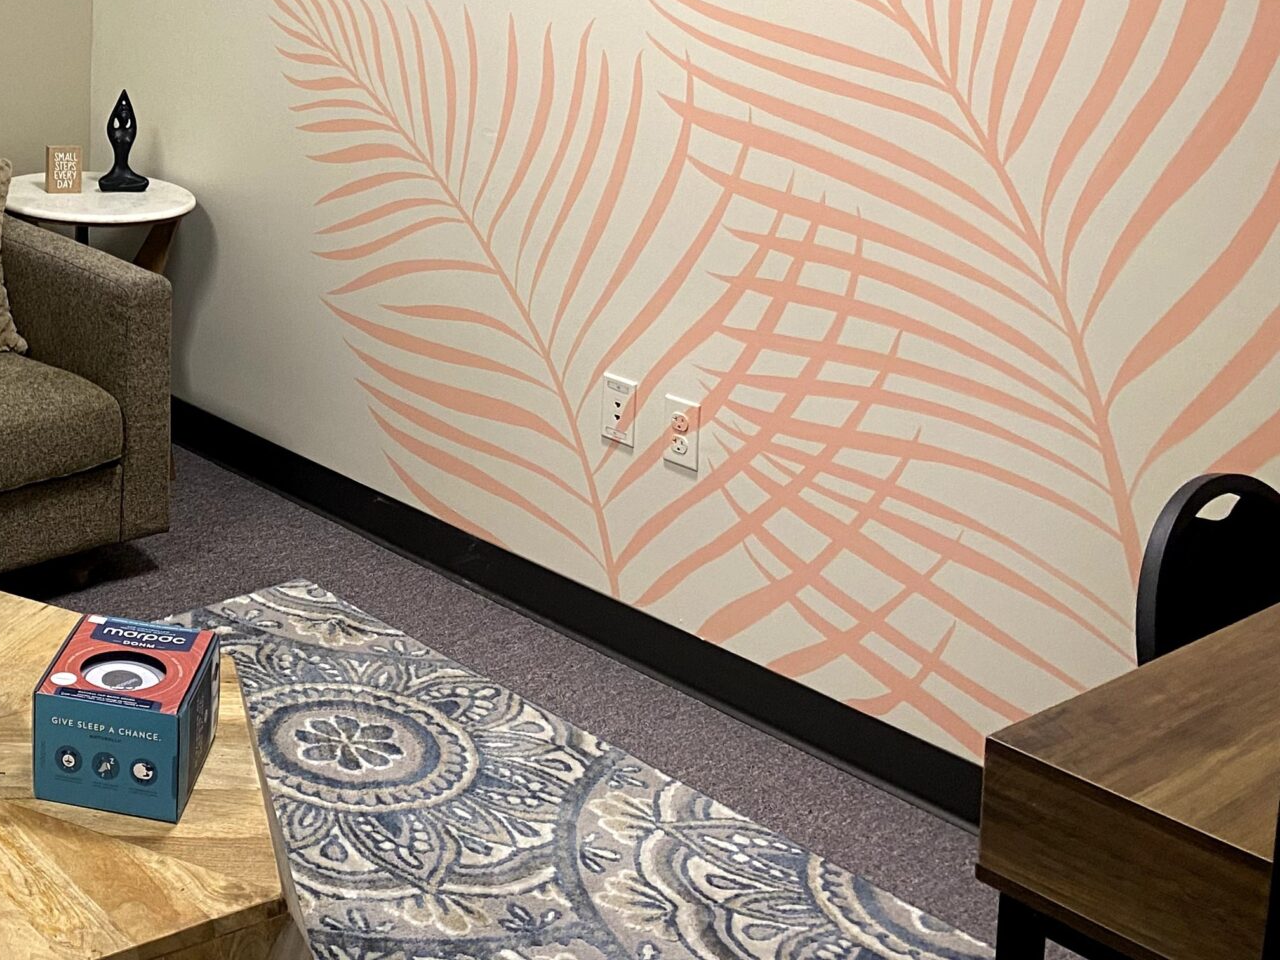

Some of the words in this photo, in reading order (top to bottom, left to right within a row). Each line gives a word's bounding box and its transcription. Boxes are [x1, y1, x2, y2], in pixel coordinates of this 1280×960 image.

[53, 151, 78, 161] SMALL
[54, 161, 77, 171] STEPS
[53, 170, 77, 180] EVERY
[56, 179, 73, 189] DAY
[102, 626, 187, 645] marpac
[51, 716, 74, 728] GIVE
[77, 720, 106, 733] SLEEP
[108, 726, 116, 734] A
[118, 727, 162, 742] CHANCE.
